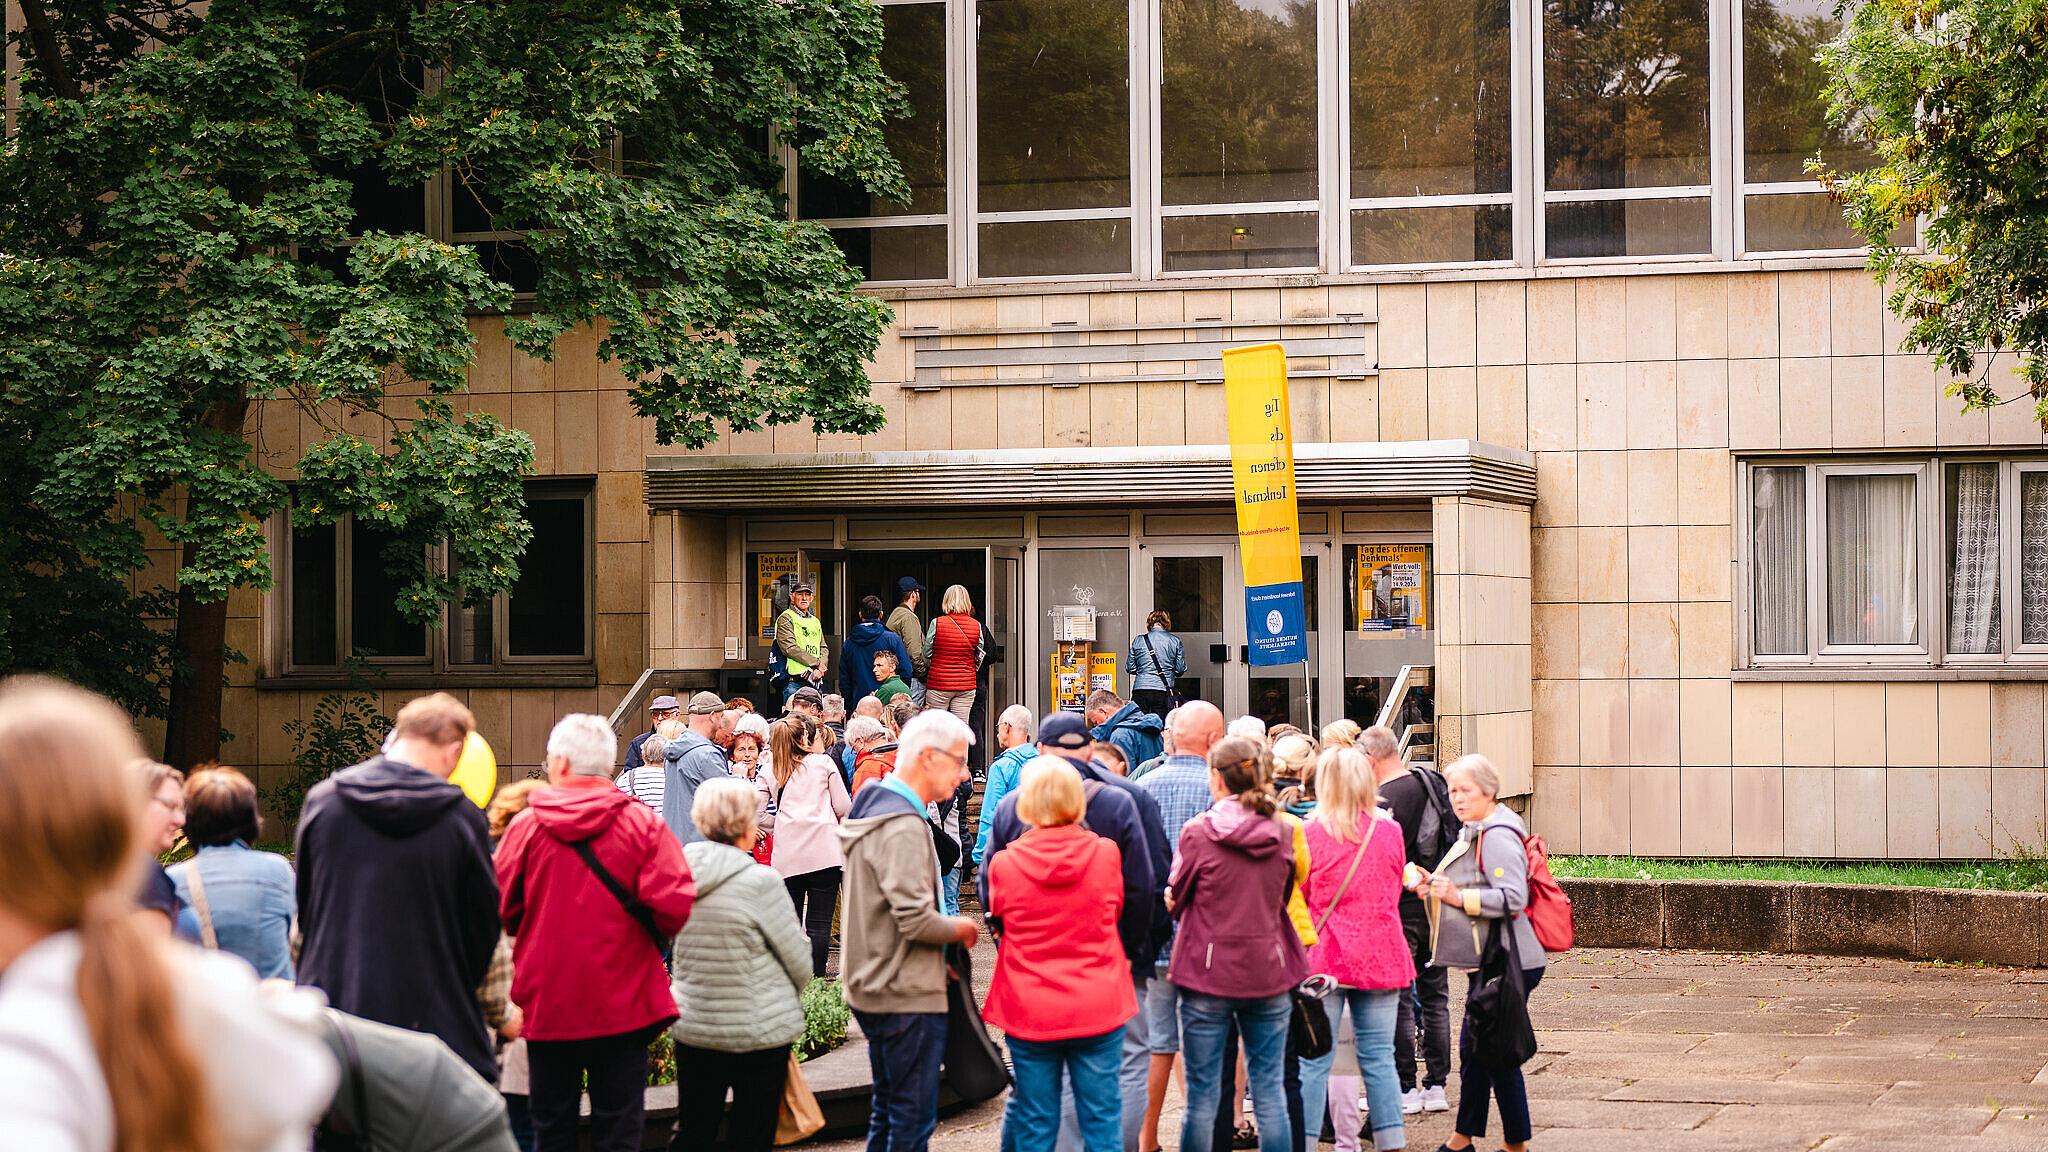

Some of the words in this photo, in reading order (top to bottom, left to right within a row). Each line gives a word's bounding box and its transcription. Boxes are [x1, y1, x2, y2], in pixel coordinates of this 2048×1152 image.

[1361, 545, 1374, 555] Tag
[1376, 545, 1390, 553] des
[1392, 545, 1424, 553] offenen
[760, 555, 774, 565] Tag
[775, 555, 788, 563] des
[760, 563, 797, 572] Denkmals
[1092, 656, 1115, 664] fenen
